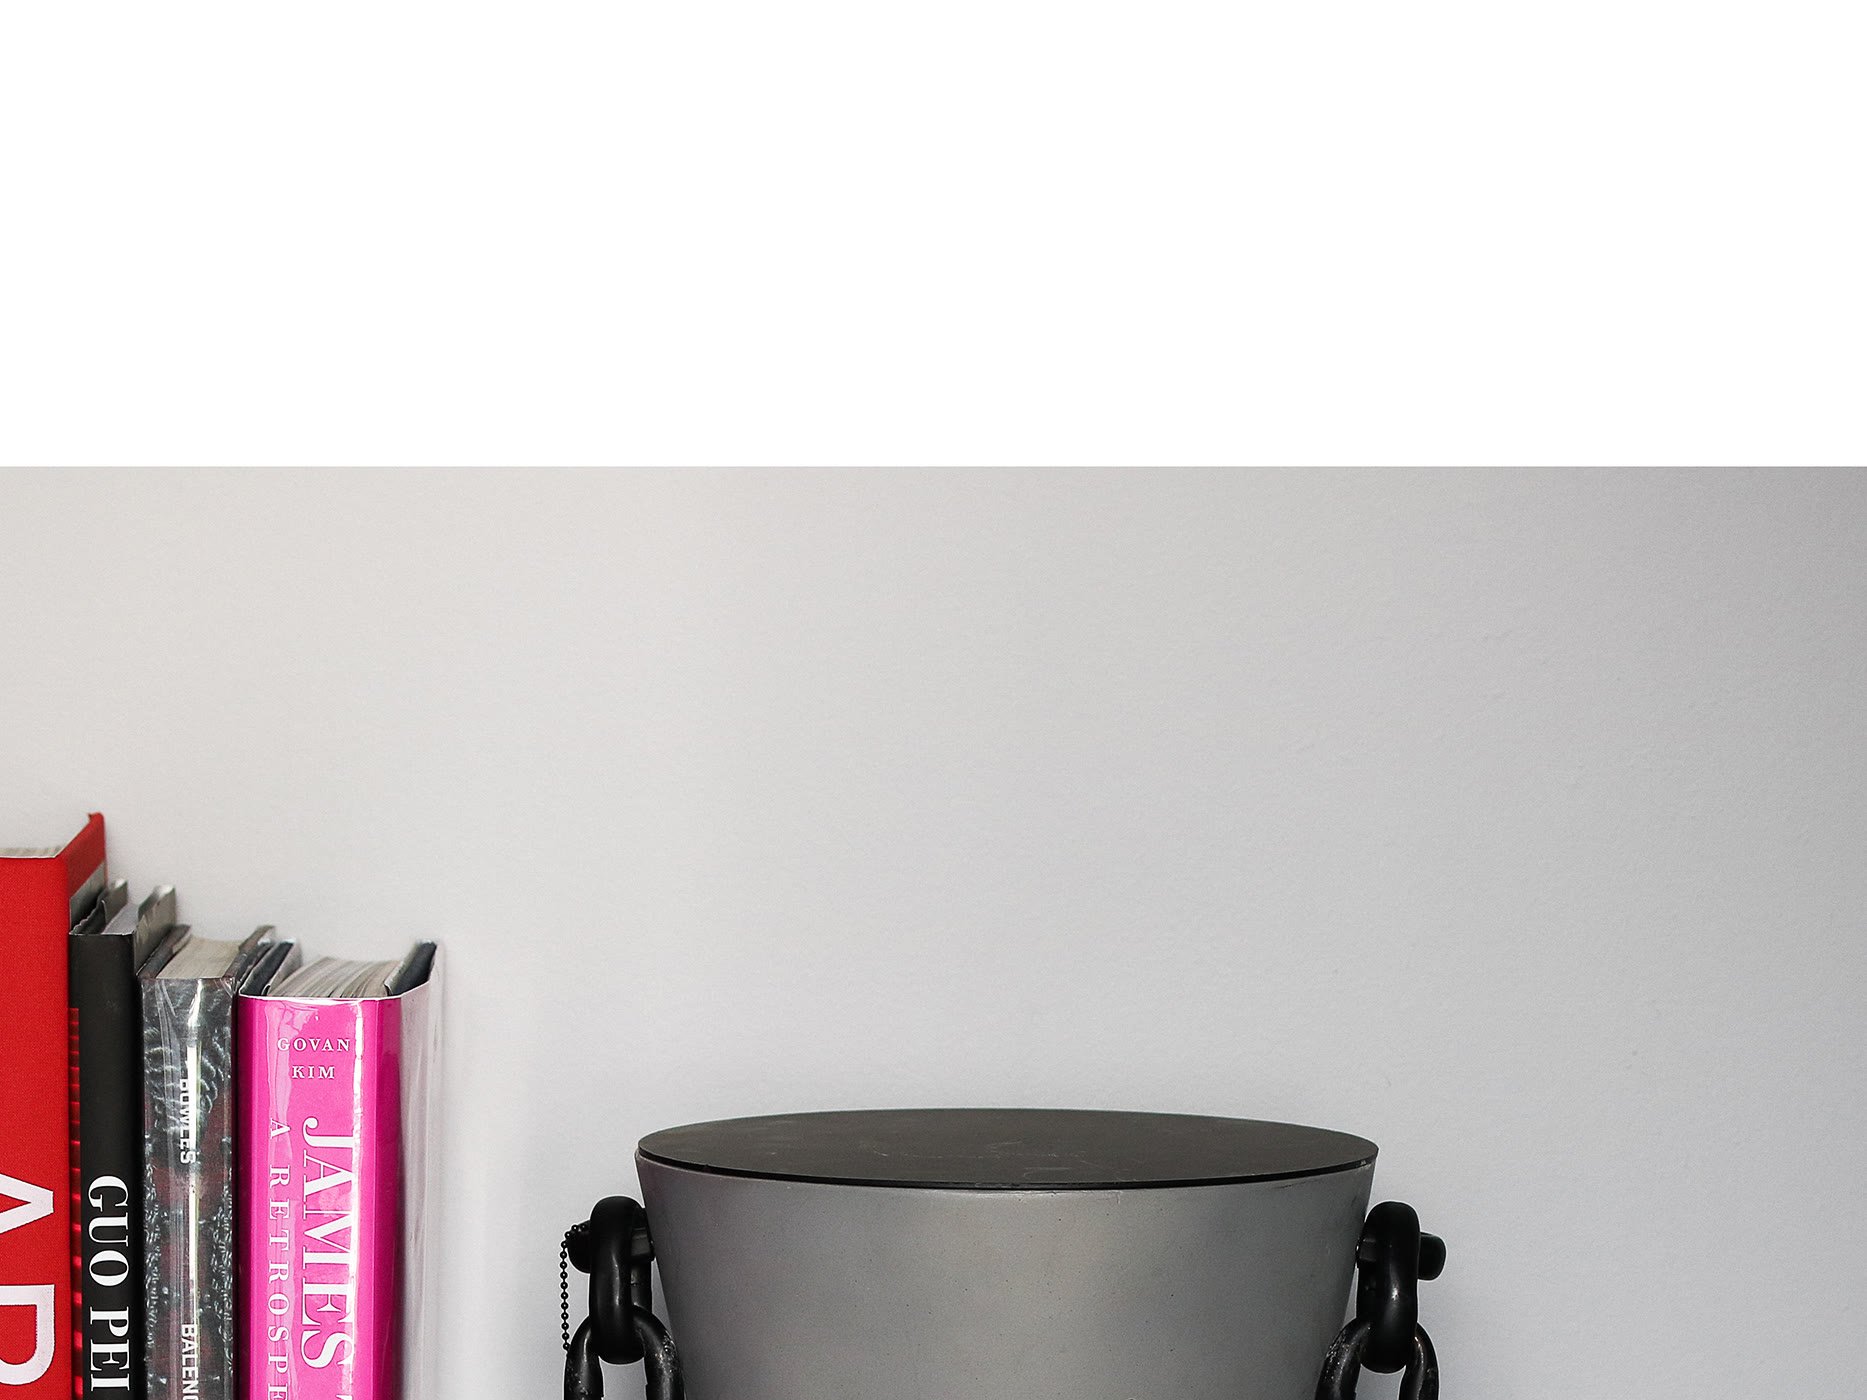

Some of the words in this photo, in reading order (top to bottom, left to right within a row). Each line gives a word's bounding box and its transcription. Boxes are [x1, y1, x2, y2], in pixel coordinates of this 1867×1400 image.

[277, 1037, 352, 1052] GOVAN
[291, 1065, 336, 1079] KIM
[268, 1117, 291, 1139] A
[87, 1174, 129, 1287] GUO
[300, 1116, 355, 1370] JAMES
[87, 1305, 130, 1392] PEI
